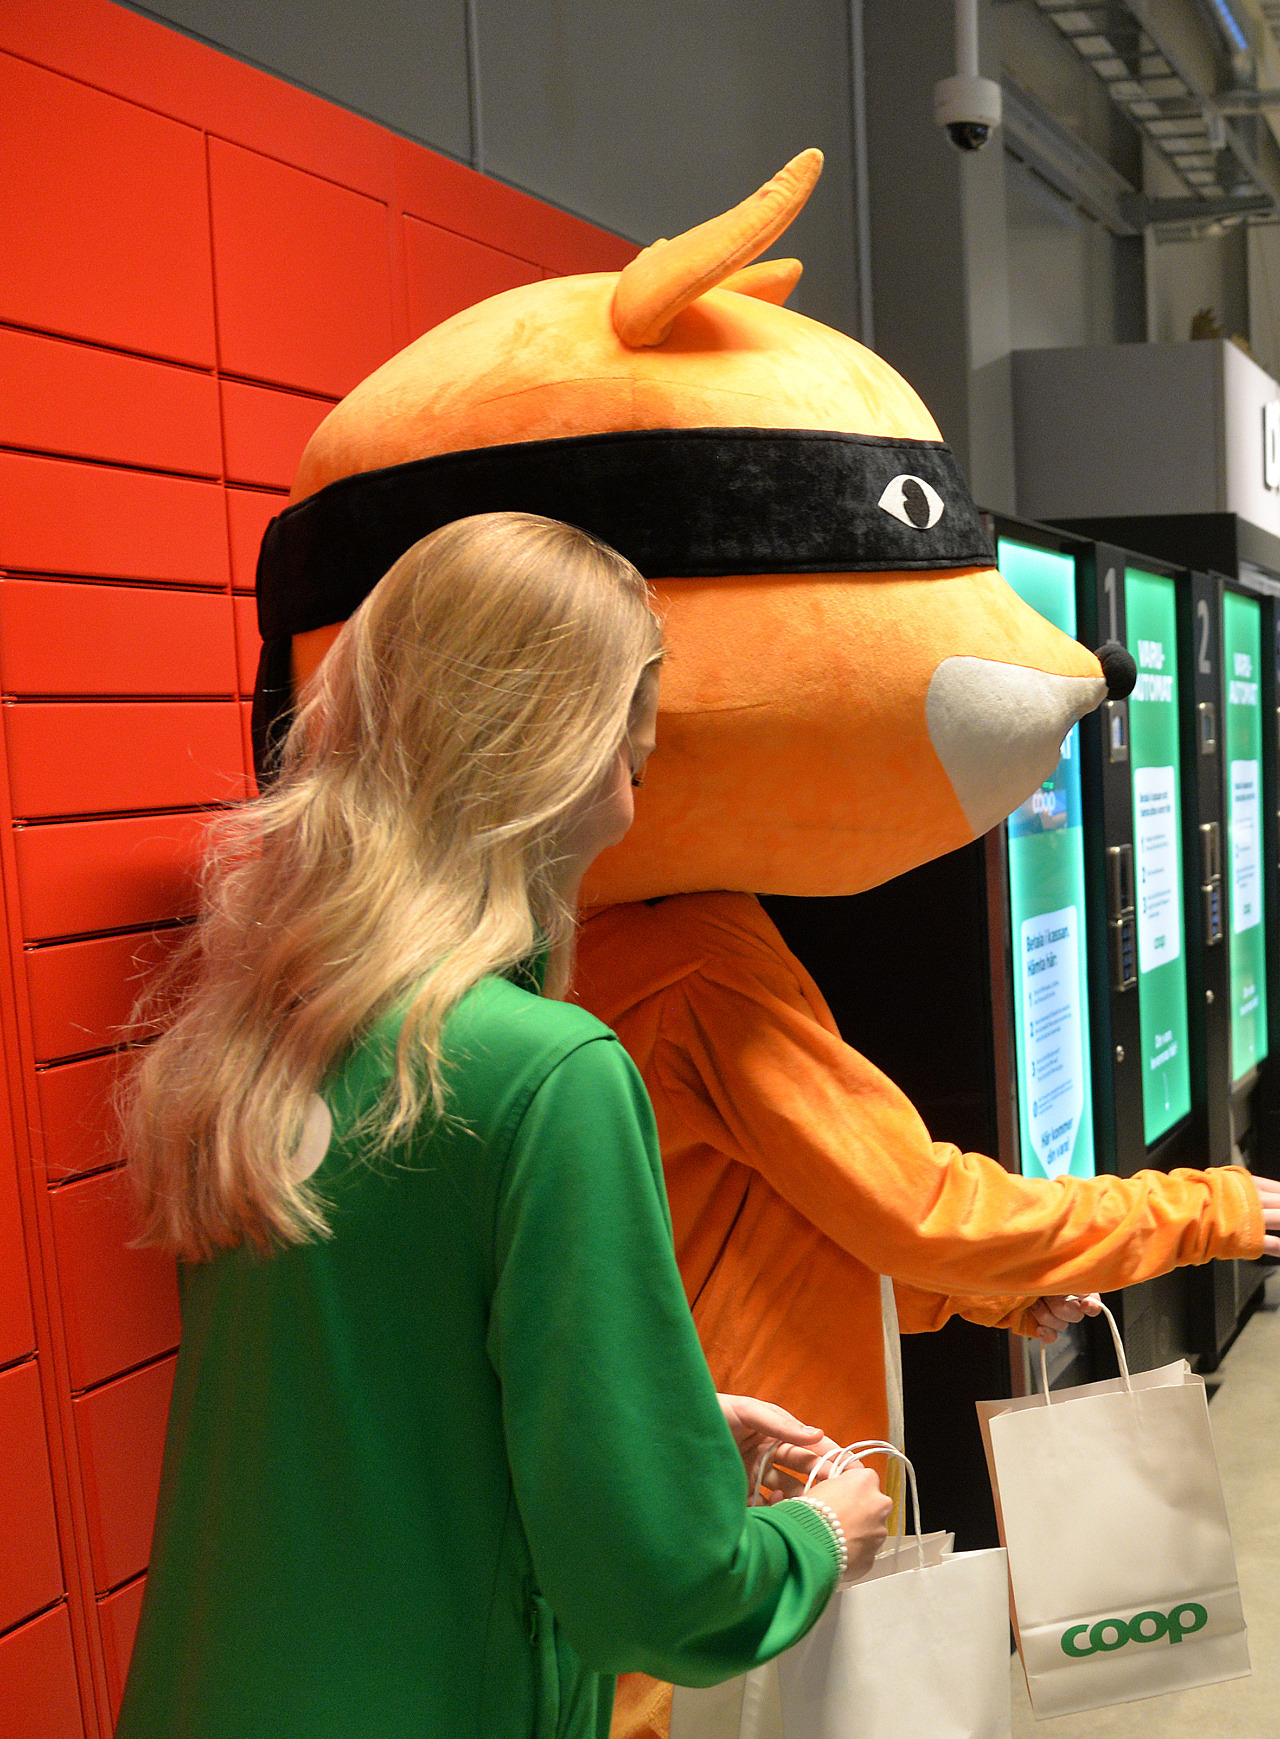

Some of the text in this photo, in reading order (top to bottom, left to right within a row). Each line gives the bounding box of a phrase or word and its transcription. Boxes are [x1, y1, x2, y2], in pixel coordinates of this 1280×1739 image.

[1104, 568, 1121, 645] 1
[1198, 599, 1211, 674] 2
[1061, 1602, 1208, 1657] coop
